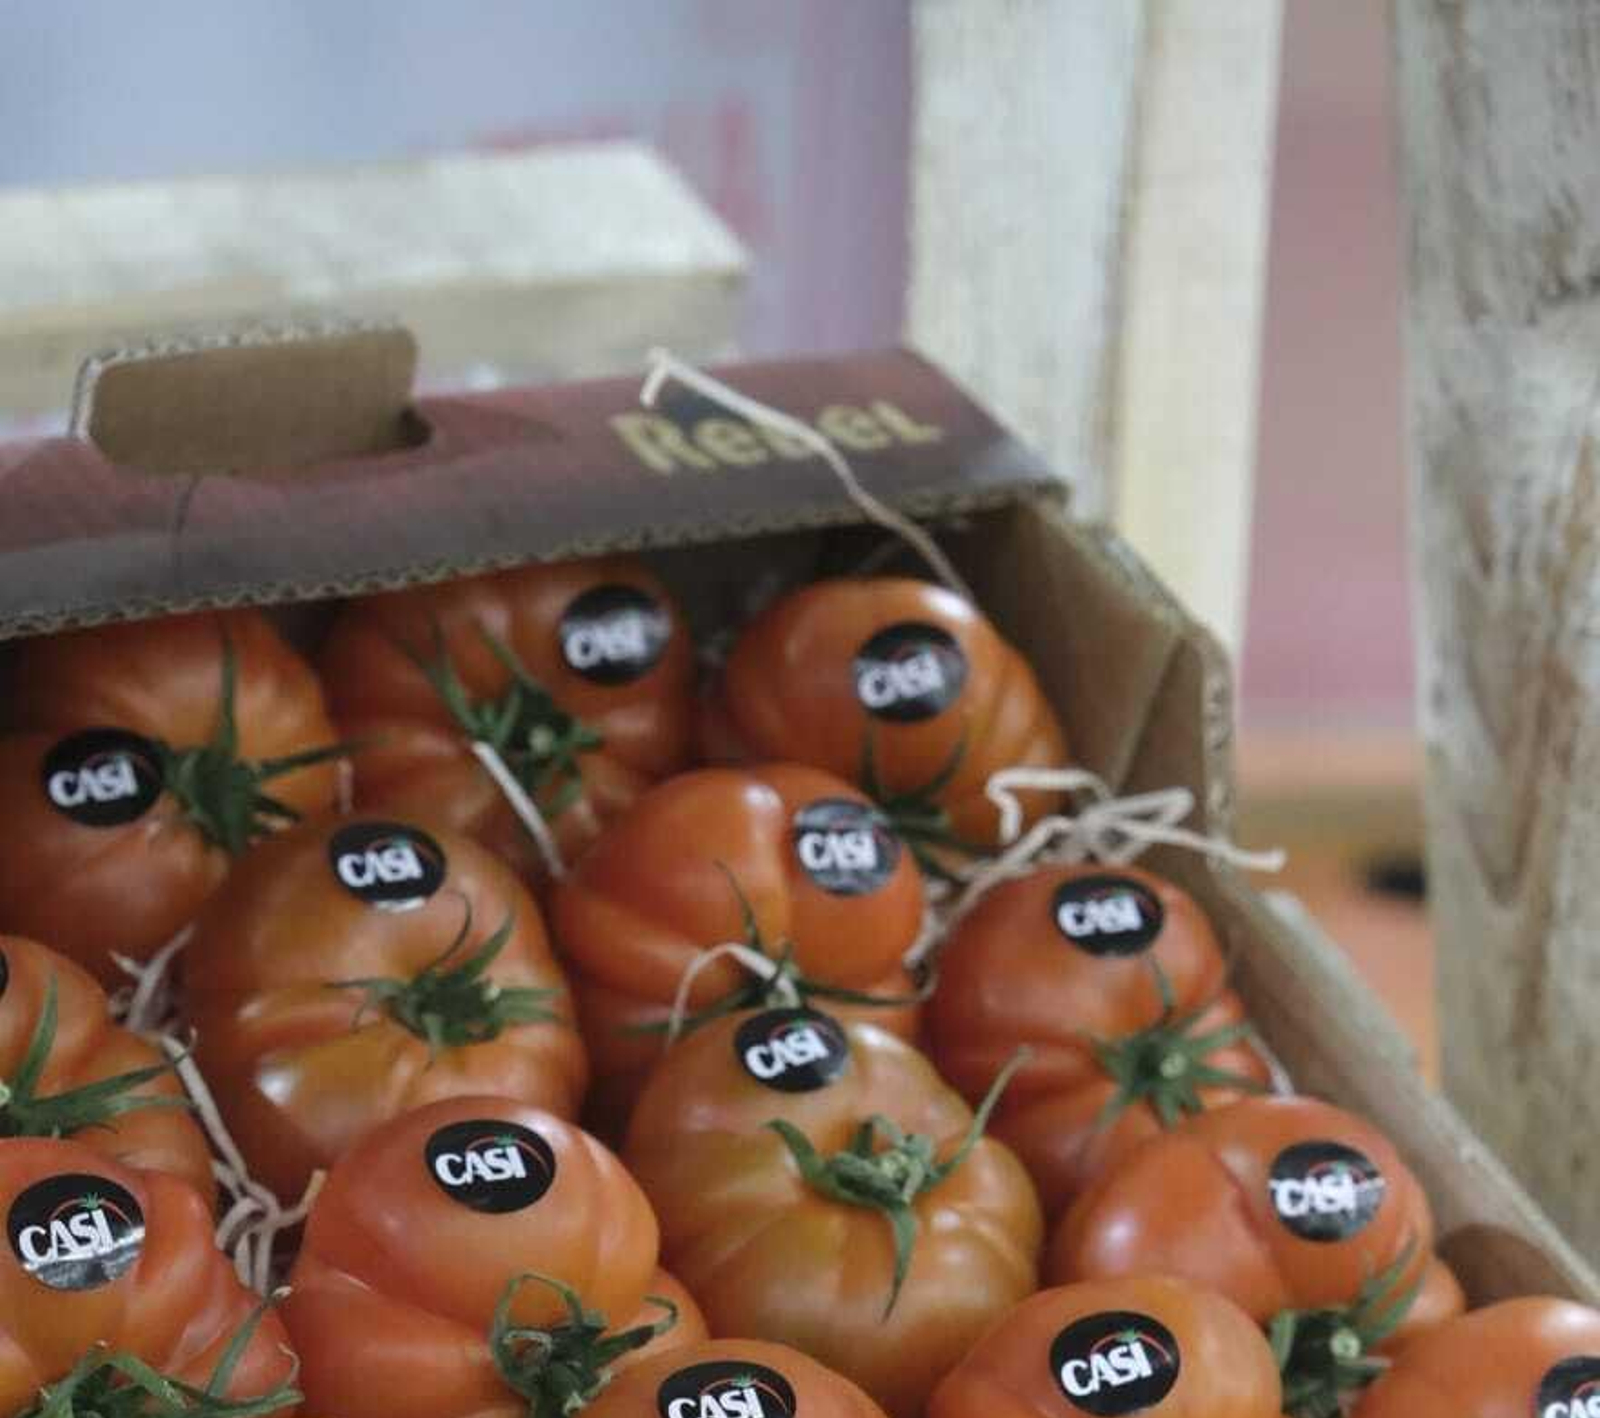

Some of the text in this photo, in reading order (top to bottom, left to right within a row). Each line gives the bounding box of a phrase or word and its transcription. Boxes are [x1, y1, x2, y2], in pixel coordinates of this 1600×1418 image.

[49, 755, 138, 806] CASI
[337, 845, 423, 887] CASI
[799, 830, 877, 870] CASI
[1057, 893, 1145, 937] CASI
[745, 1026, 830, 1078] CASI
[434, 1143, 527, 1187] CASI
[1274, 1173, 1358, 1216] CASI
[18, 1207, 114, 1264] CASI
[1060, 1339, 1154, 1397] CASI
